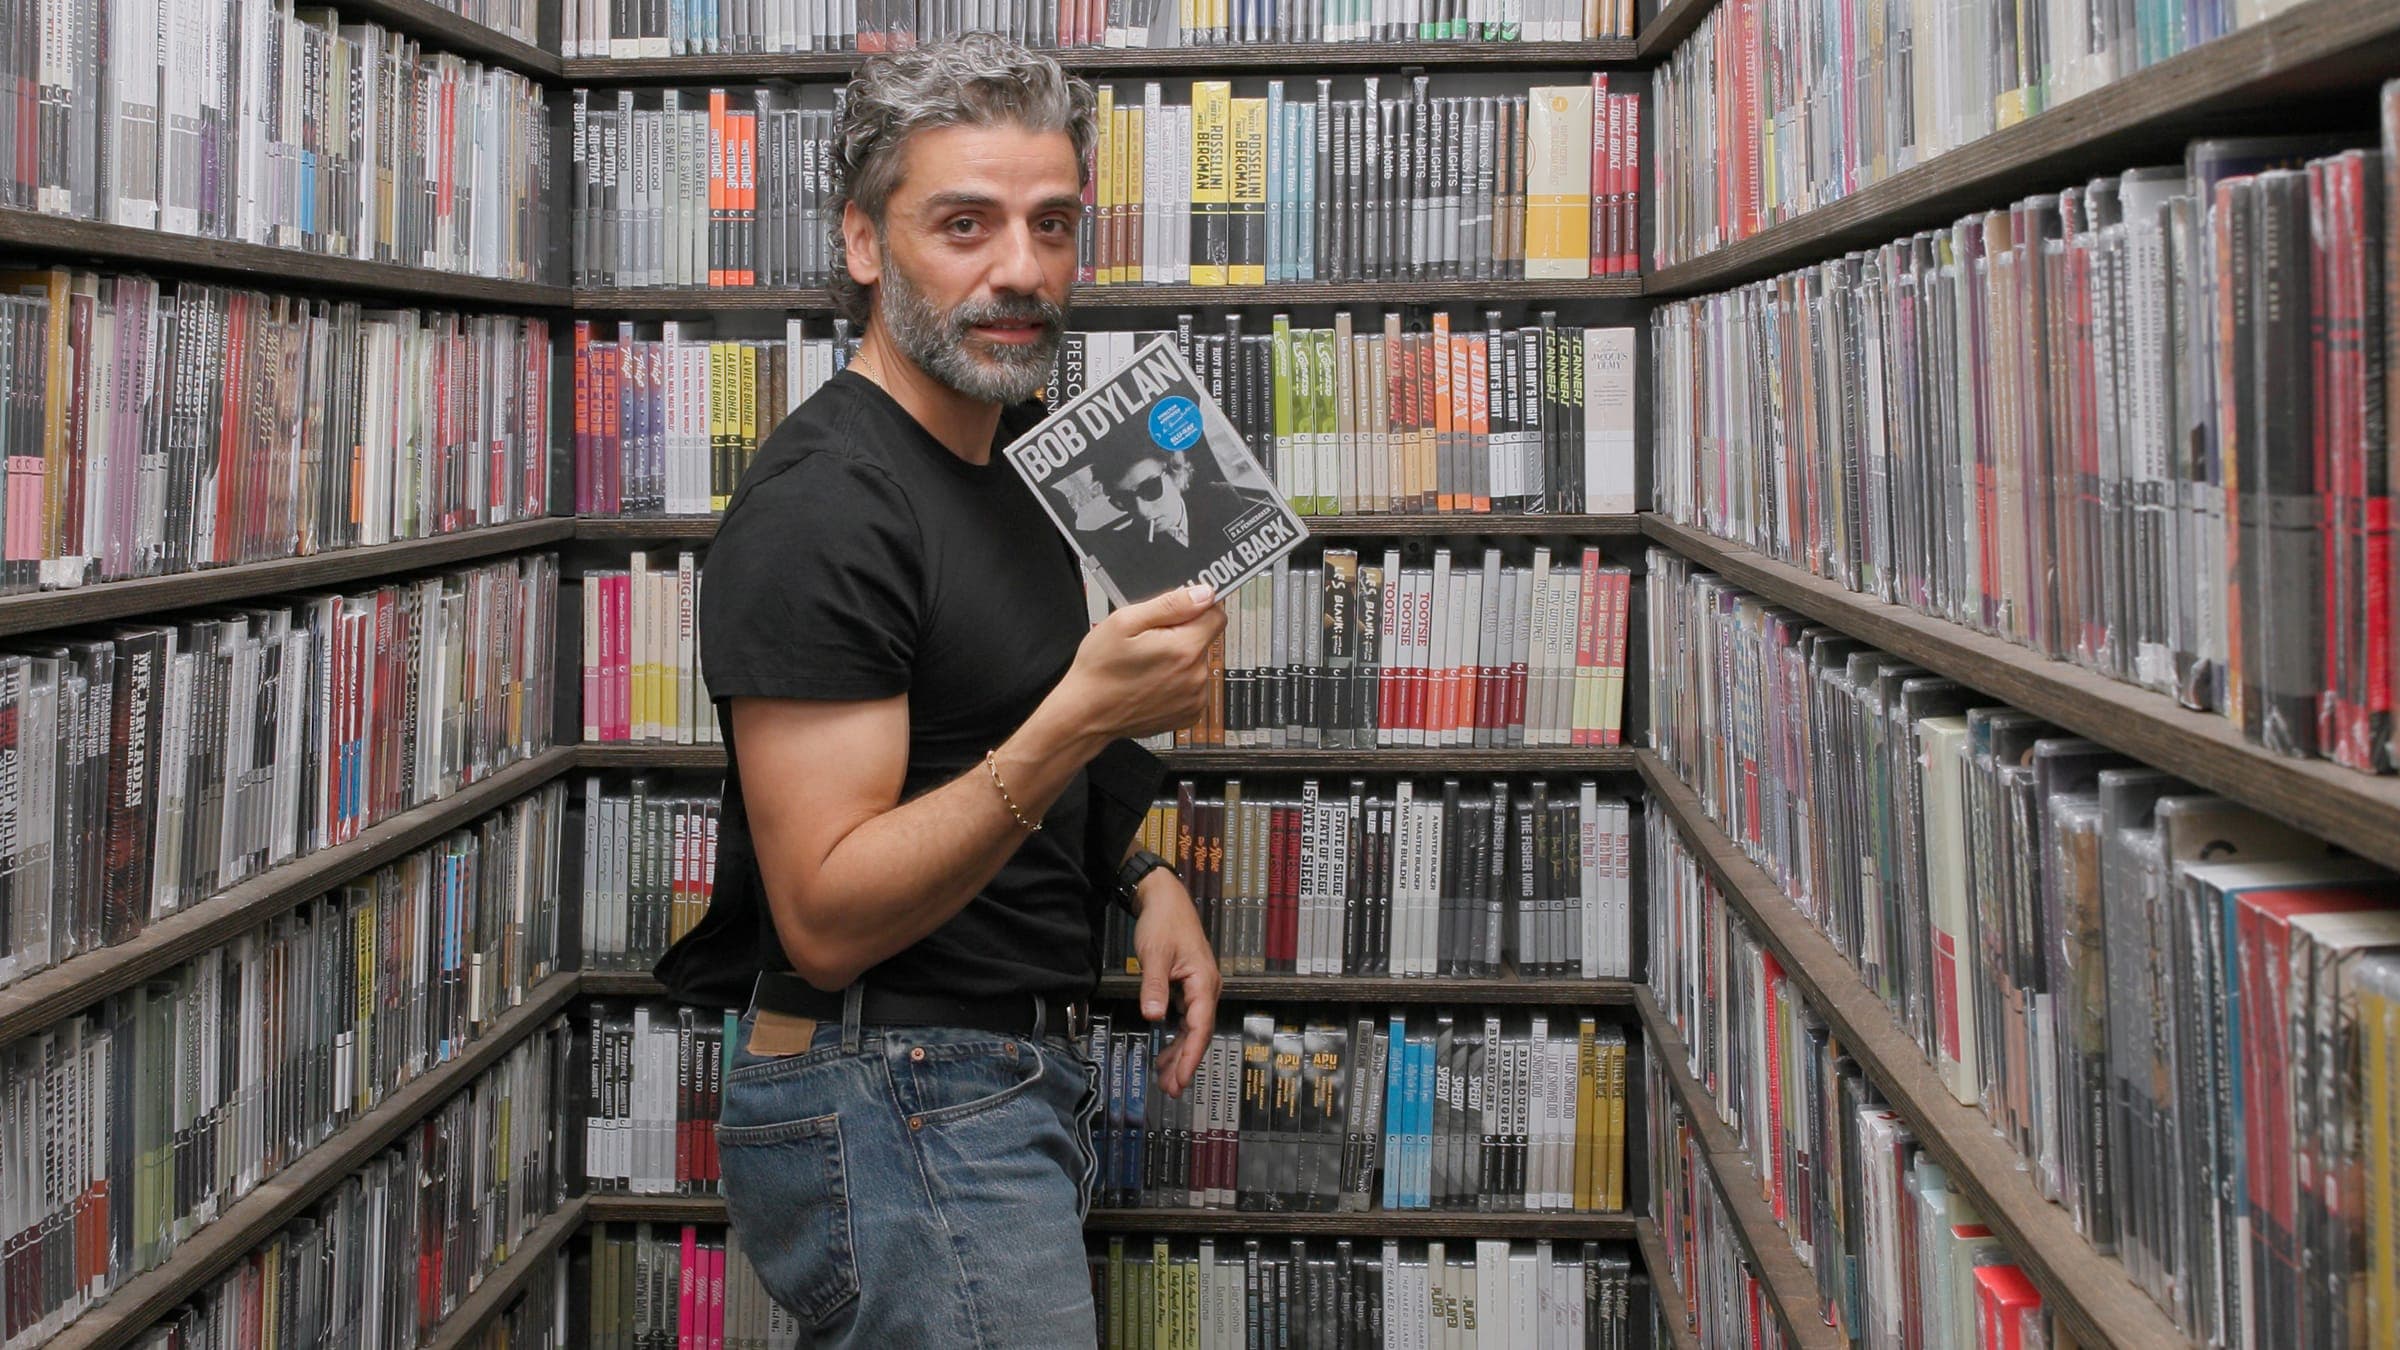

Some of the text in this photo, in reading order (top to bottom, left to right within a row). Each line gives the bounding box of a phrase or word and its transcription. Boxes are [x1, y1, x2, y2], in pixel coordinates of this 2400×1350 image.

[574, 130, 585, 162] YUMA
[636, 123, 646, 193] medium cool
[652, 121, 662, 190] medium cool
[666, 98, 675, 173] LIFE IS SWEET
[696, 123, 706, 197] LIFE IS SWEET
[1197, 132, 1210, 189] BERGMAN
[1210, 125, 1223, 190] ROSSELLINI
[1248, 134, 1261, 198] ROSSELLINI
[1384, 135, 1393, 180] La Notte
[1417, 104, 1426, 179] CITY LIGHTS
[1448, 112, 1458, 187] CITY LIGHTS
[1479, 120, 1493, 190] Frances Ha
[1610, 103, 1621, 170] TOUKI BOUKI
[604, 156, 616, 187] YUMA
[1235, 141, 1247, 198] BERGMAN
[176, 301, 189, 413] YOUTH BEAST
[713, 354, 723, 424] LA VIE DE BOHÈME
[1067, 340, 1081, 398] PERSO
[1212, 347, 1222, 366] RIOT
[1212, 368, 1222, 377] IN
[1453, 347, 1467, 420] JUDEX
[1471, 349, 1485, 424] JUDEX
[1525, 344, 1537, 368] HARD
[1525, 370, 1537, 396] DAY'S
[1546, 327, 1556, 403] SCANNERS
[1572, 336, 1583, 407] SCANNERS
[1016, 349, 1183, 482] BOB DYLAN
[1525, 398, 1537, 425] NIGHT
[1187, 516, 1295, 593] OOK BACK
[1332, 566, 1346, 589] LES
[1364, 573, 1377, 595] LES
[681, 572, 691, 641] BIG CHILL
[1385, 582, 1396, 636] TOOTSIE
[1401, 592, 1412, 647] TOOTSIE
[127, 689, 138, 764] CONFIDENTIAL
[131, 652, 148, 806] MR. ARKADIN
[3, 750, 18, 857] SLEEP WELL
[1400, 806, 1409, 846] MASTER
[632, 795, 642, 888] EVERY MAN FOR HIMSELF
[691, 815, 702, 881] don't look now
[1301, 789, 1316, 896] STATE OF SIEGE
[1333, 811, 1345, 897] STATE OF SIEGE
[1399, 848, 1408, 890] BUILDER
[1521, 814, 1533, 897] THE FISHER KING
[695, 1041, 705, 1093] DRESSED TO
[1132, 1043, 1142, 1085] MULHOLLAND
[1245, 1046, 1269, 1057] APU
[1276, 1054, 1300, 1066] APU
[1486, 1028, 1497, 1111] BURROUGHS
[1211, 1049, 1222, 1121] In Cold Blood
[1452, 1075, 1465, 1112] SPEEDY
[1469, 1075, 1481, 1112] SPEEDY
[1517, 1050, 1527, 1134] BURROUGHS
[46, 1042, 54, 1208] BRUTE FORCE
[1202, 1273, 1211, 1320] Barcelona
[1431, 1287, 1444, 1317] PLAYER
[1463, 1300, 1475, 1330] PLAYER
